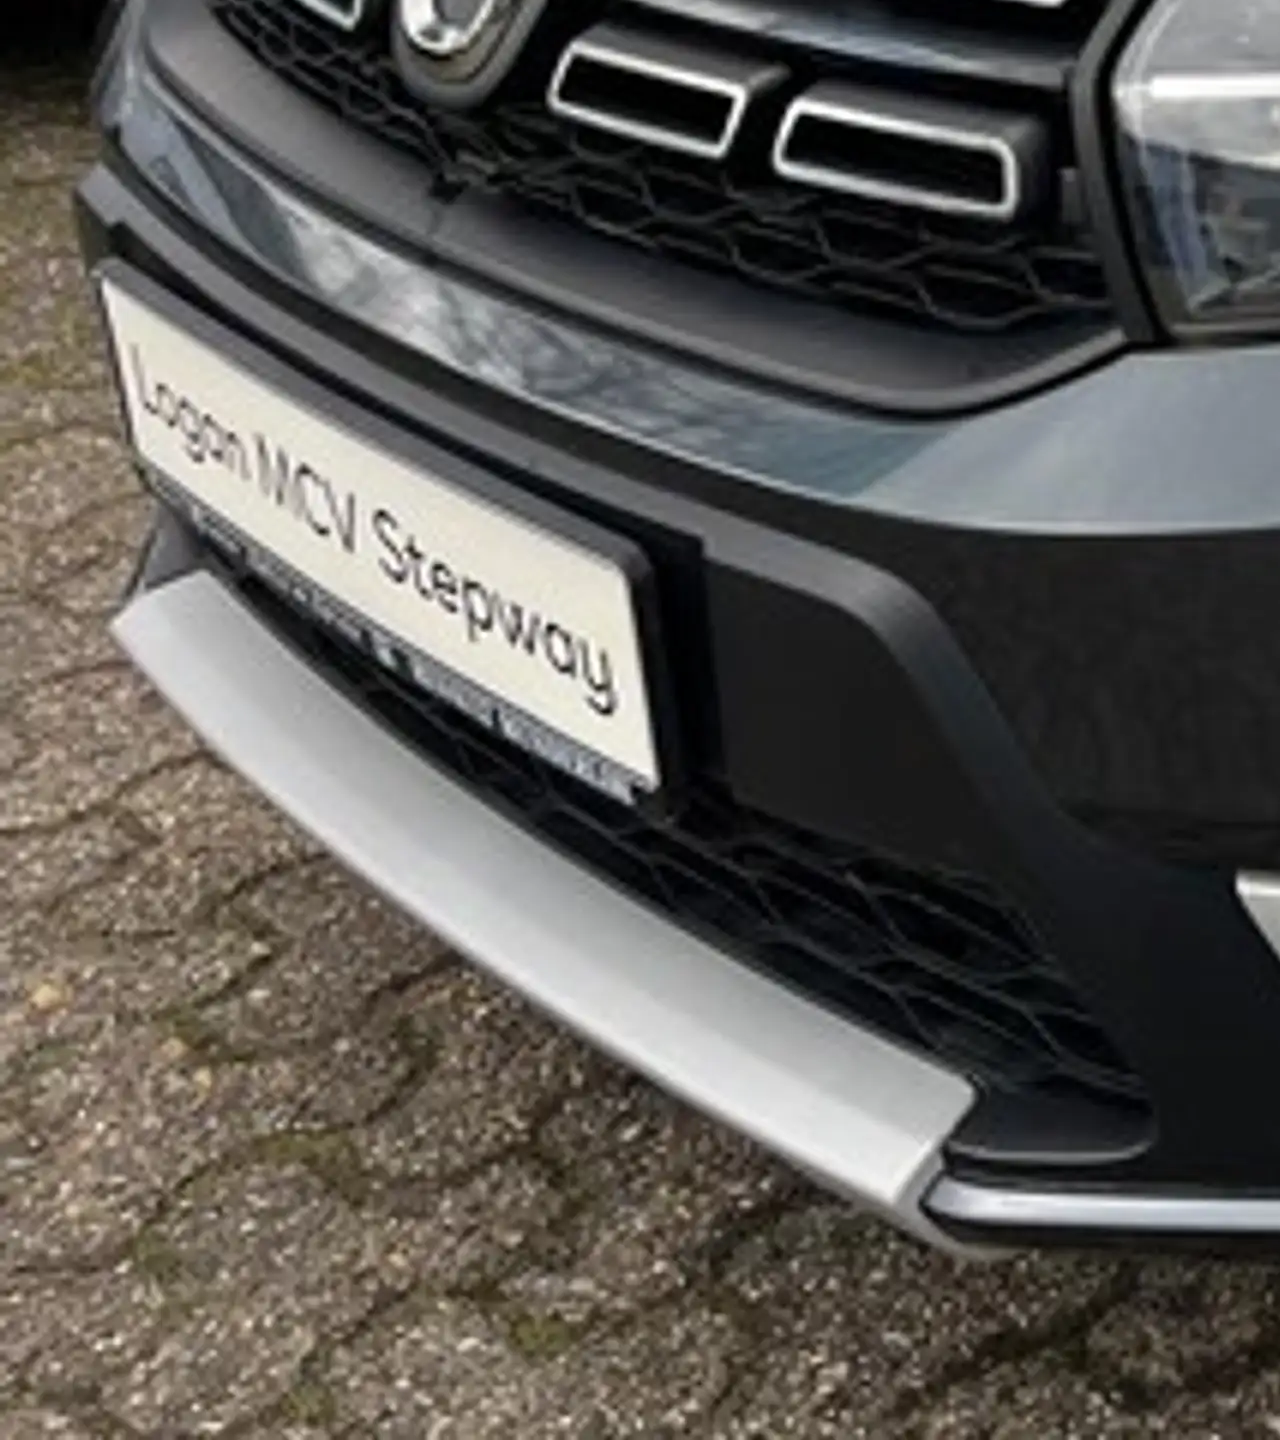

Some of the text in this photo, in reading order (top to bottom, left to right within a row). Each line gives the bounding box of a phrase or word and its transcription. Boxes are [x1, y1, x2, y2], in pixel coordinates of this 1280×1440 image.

[133, 343, 254, 481] Logan
[254, 434, 357, 554] MCV
[372, 509, 617, 716] Stepway
